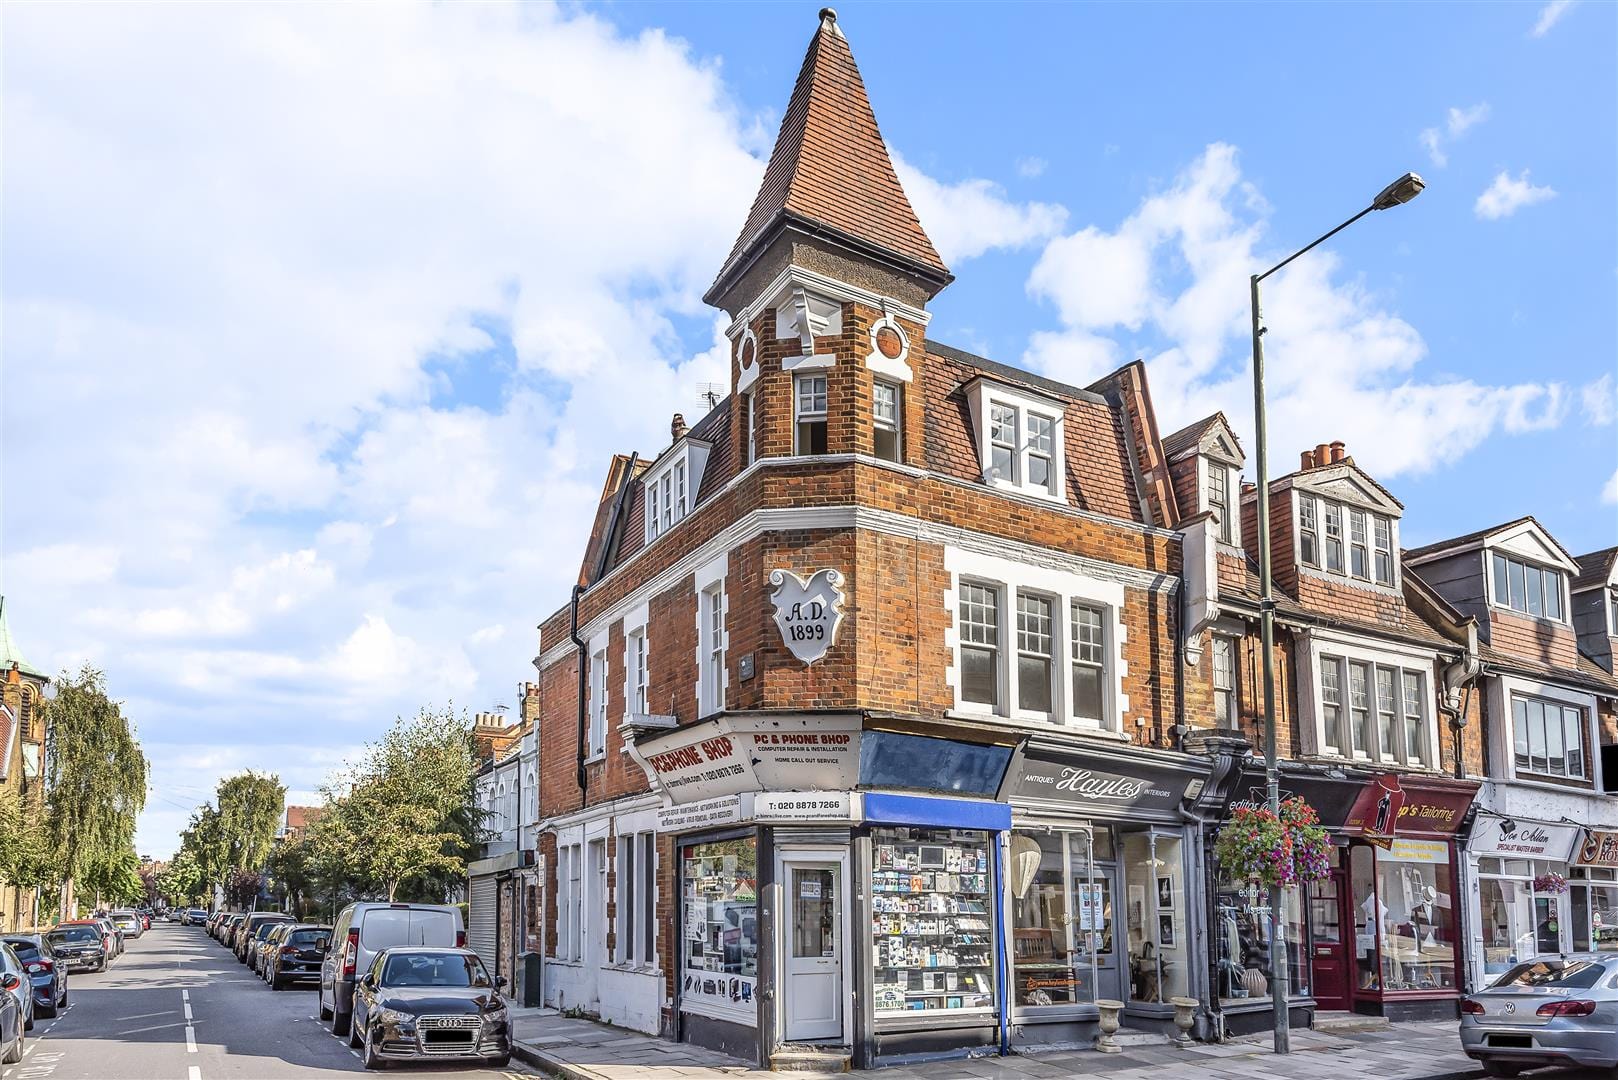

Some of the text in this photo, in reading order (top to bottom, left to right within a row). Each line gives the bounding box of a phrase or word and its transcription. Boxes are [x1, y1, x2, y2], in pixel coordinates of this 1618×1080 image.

[785, 602, 827, 621] A.D.
[789, 624, 824, 641] 1899
[700, 736, 733, 761] SHOP
[753, 734, 851, 745] PC & PHONE SHOP
[1025, 767, 1171, 799] ANTIQUES Hayles INTERIORS
[769, 800, 840, 810] T: 020 8878 7266
[1418, 804, 1456, 822] Tailoring
